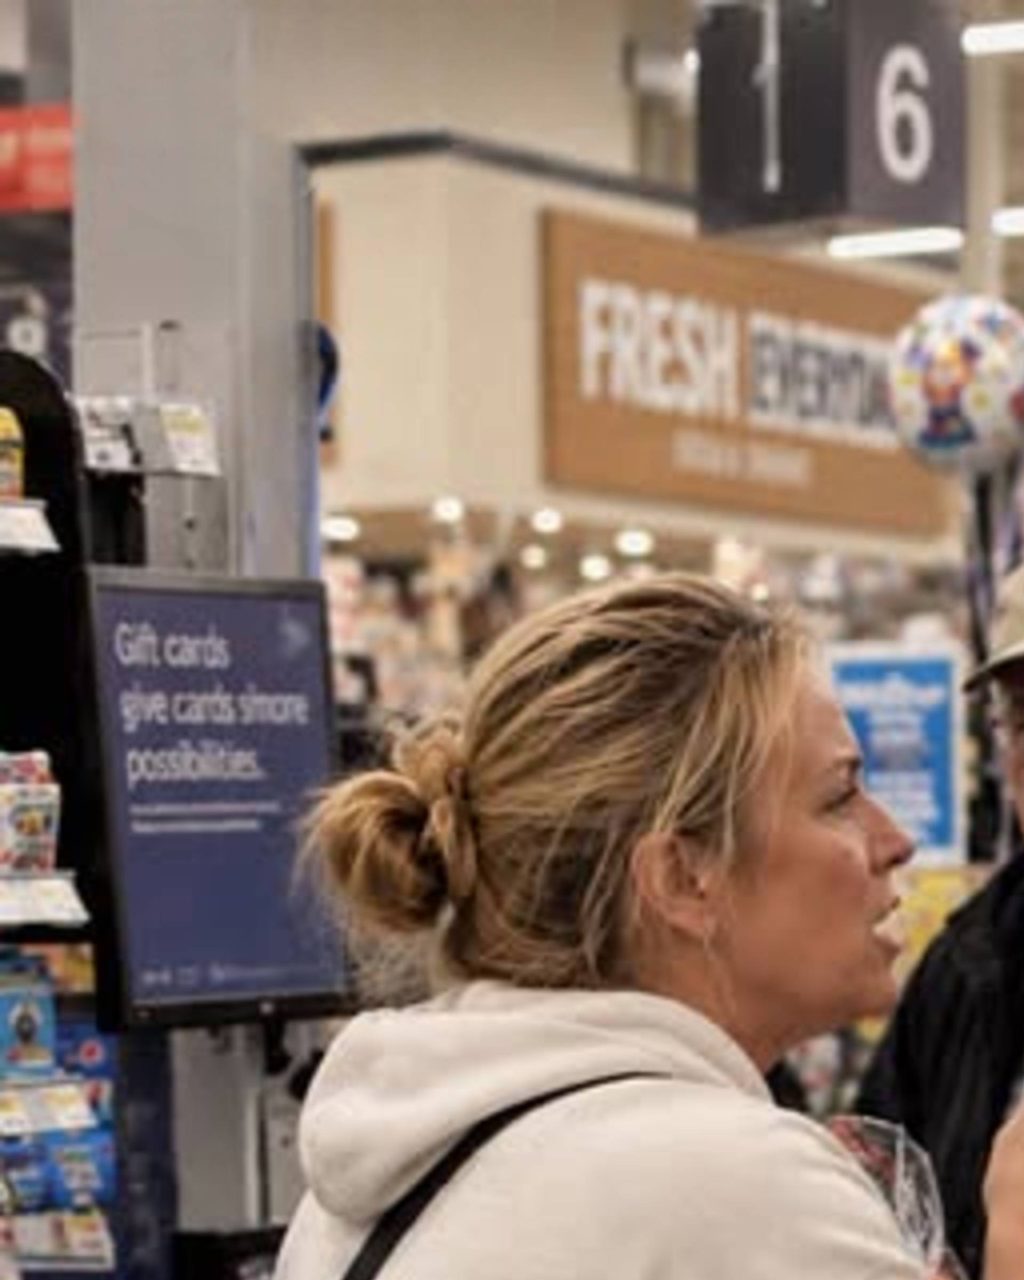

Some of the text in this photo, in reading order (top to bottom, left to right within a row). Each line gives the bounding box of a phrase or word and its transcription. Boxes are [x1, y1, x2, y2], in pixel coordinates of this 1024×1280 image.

[877, 43, 934, 182] 6
[578, 278, 739, 422] FRESH
[115, 622, 231, 668] Gift cards
[120, 681, 169, 732] give
[172, 684, 236, 724] cards
